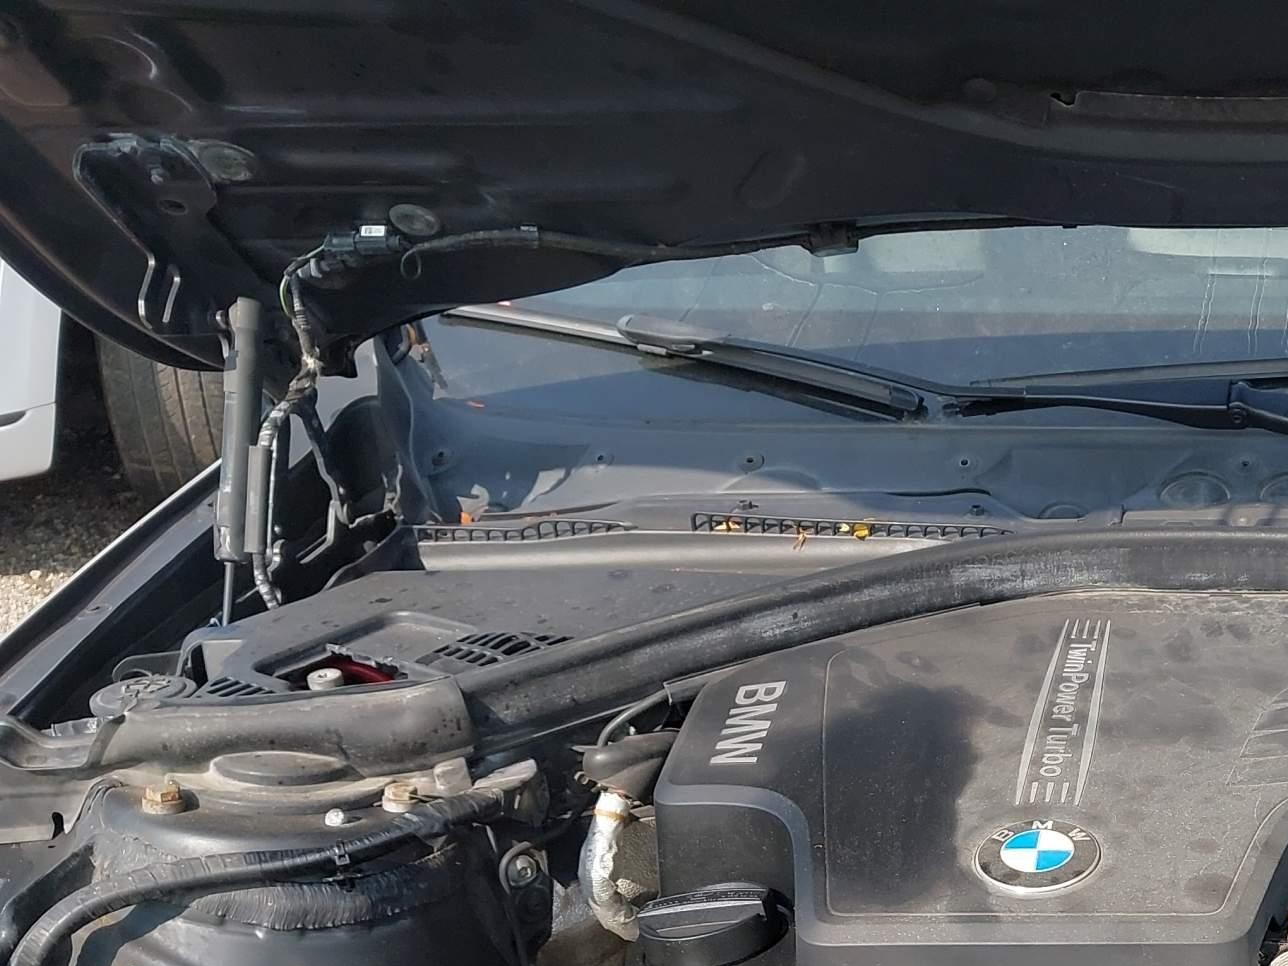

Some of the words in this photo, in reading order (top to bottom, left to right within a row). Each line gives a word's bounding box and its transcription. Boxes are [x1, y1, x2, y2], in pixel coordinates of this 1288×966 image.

[1051, 639, 1097, 722] TwinPower
[709, 680, 787, 764] BMW
[1039, 723, 1080, 777] Turbo
[991, 820, 1091, 842] BMW
